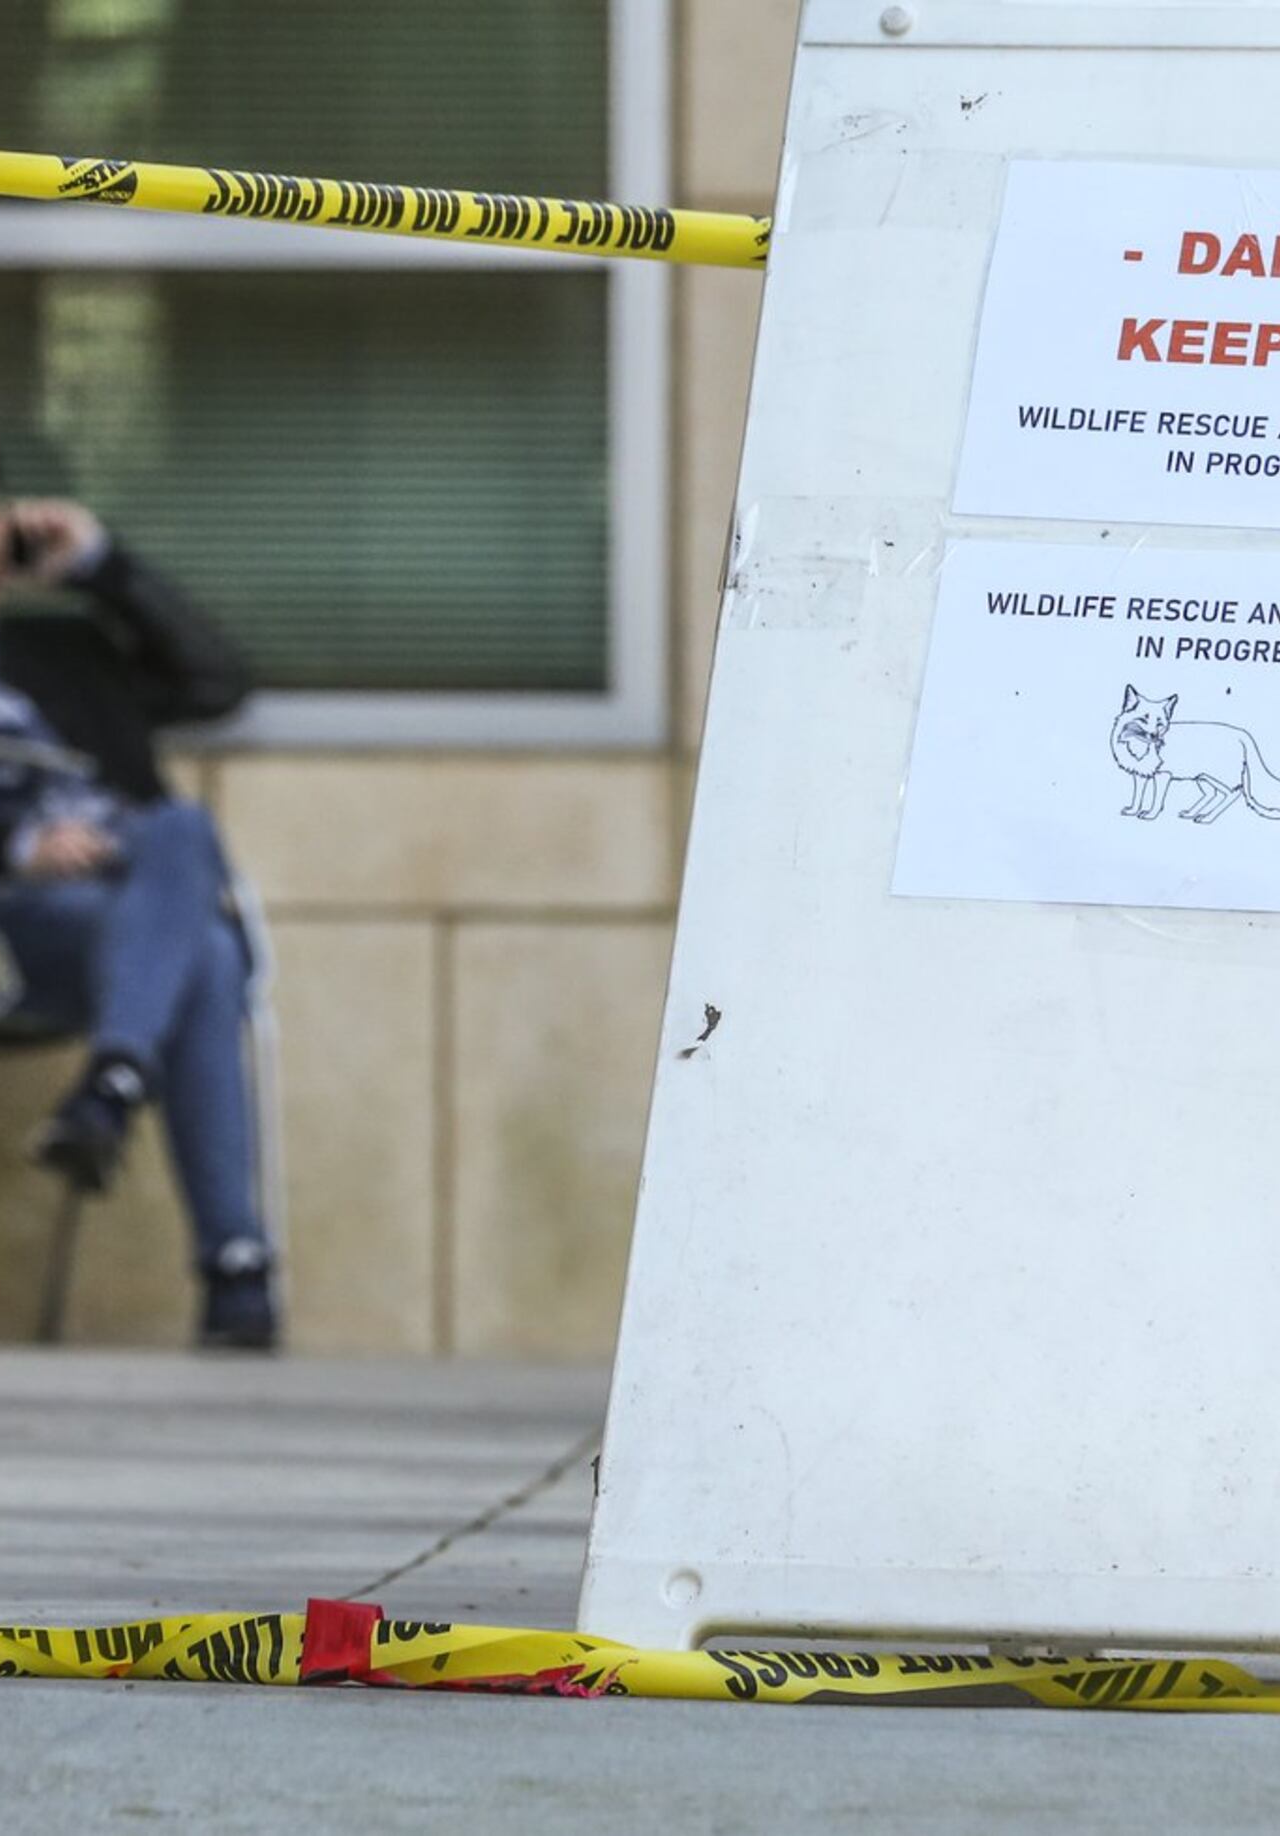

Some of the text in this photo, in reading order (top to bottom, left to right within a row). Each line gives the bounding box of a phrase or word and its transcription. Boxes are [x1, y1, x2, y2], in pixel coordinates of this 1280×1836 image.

[1018, 405, 1147, 433] WILDLIFE
[1157, 411, 1269, 439] RESCUE
[1166, 450, 1195, 474] IN
[987, 592, 1117, 619] WILDLIFE
[1126, 597, 1239, 624] RESCUE
[1135, 635, 1165, 659] IN
